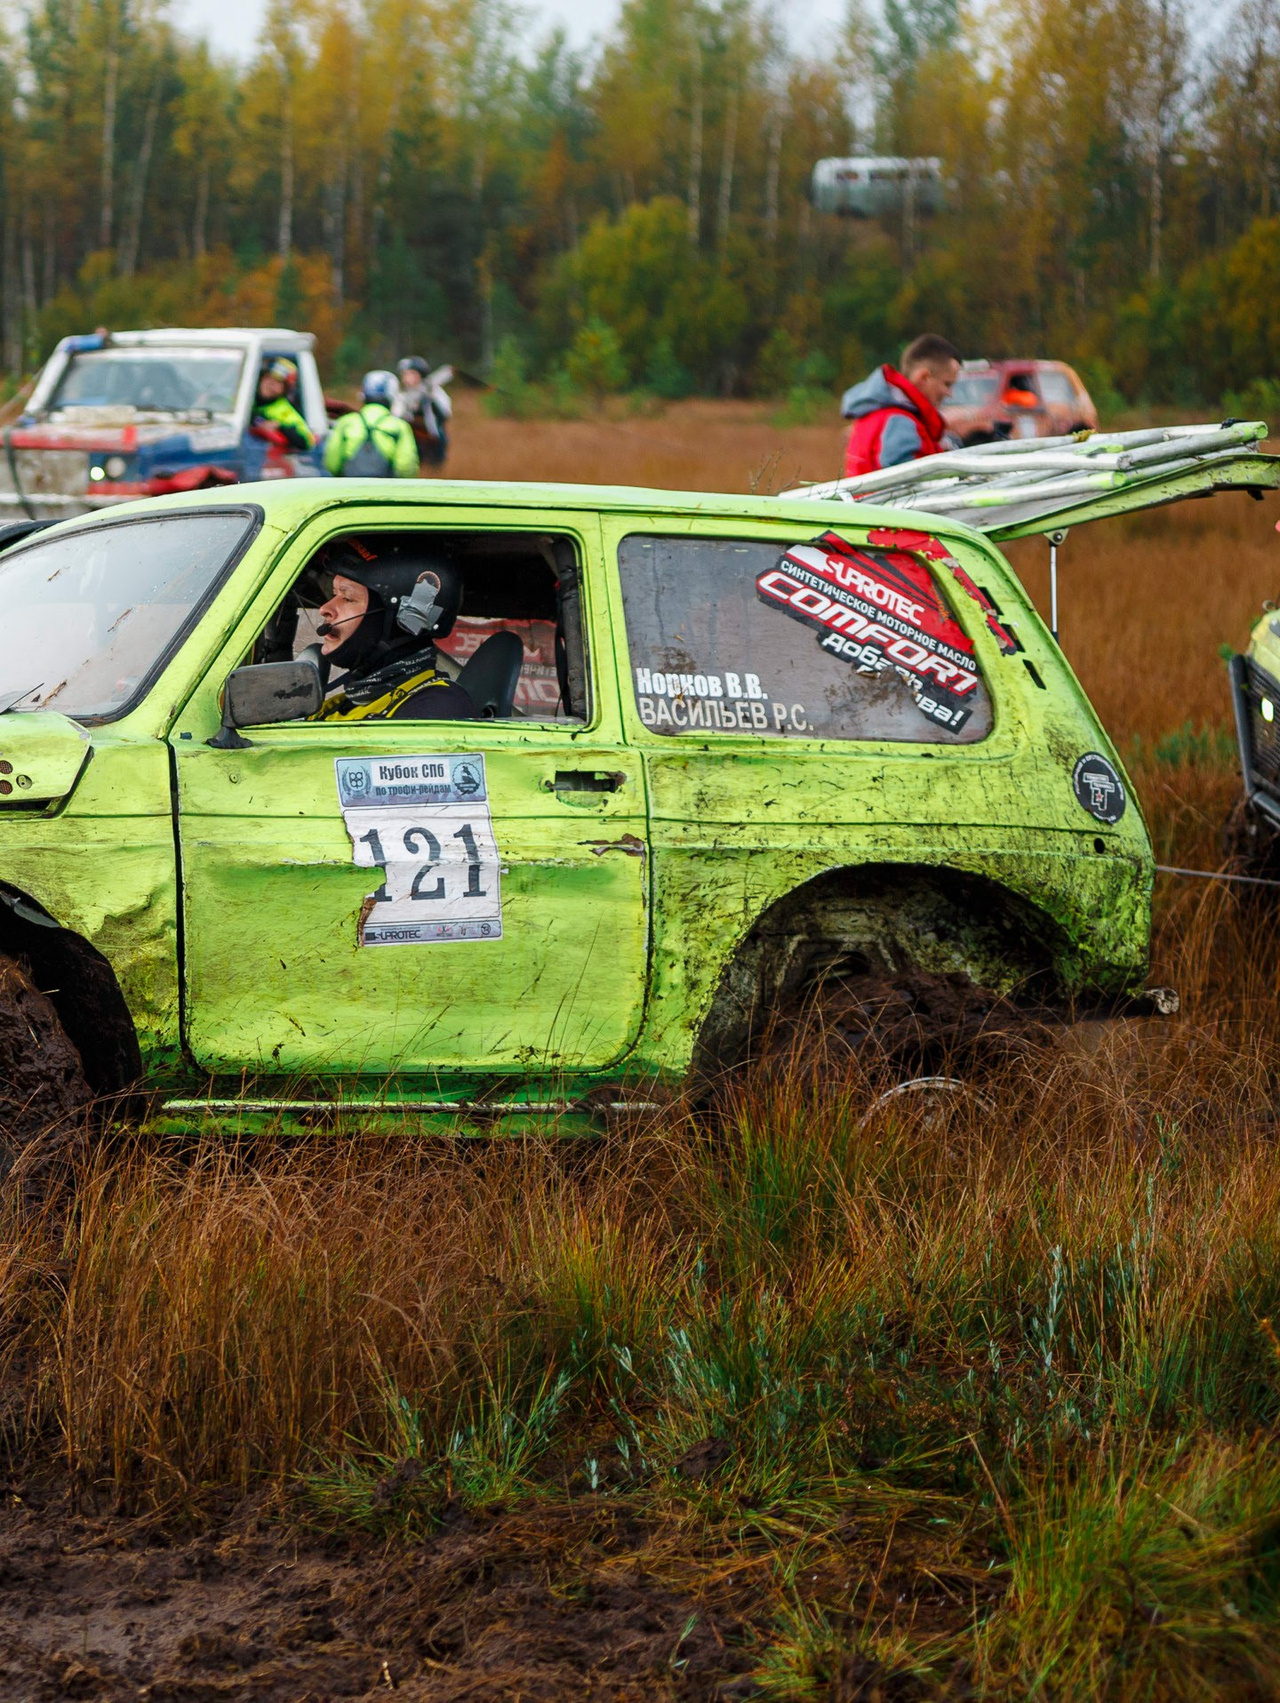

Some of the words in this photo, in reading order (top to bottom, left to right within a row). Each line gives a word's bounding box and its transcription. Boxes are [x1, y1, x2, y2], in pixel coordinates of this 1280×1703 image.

[825, 560, 925, 626] SUPROTEC
[758, 571, 978, 692] COMFORT
[780, 560, 876, 619] СИНТЕТИЧЕСКОЕ
[876, 612, 937, 651] МОТОРНОЕ
[937, 643, 977, 672] МАСЛО
[635, 667, 724, 697] Норков
[724, 672, 769, 700] В.В.
[638, 697, 768, 729] ВАСИЛЬЕВ
[772, 702, 814, 731] Р.С.
[379, 764, 419, 781] Кубок
[421, 763, 445, 778] СПб
[375, 786, 387, 796] по
[388, 783, 452, 796] трофи-рейдам
[359, 823, 487, 902] 121
[374, 929, 422, 941] SUPROTEC
